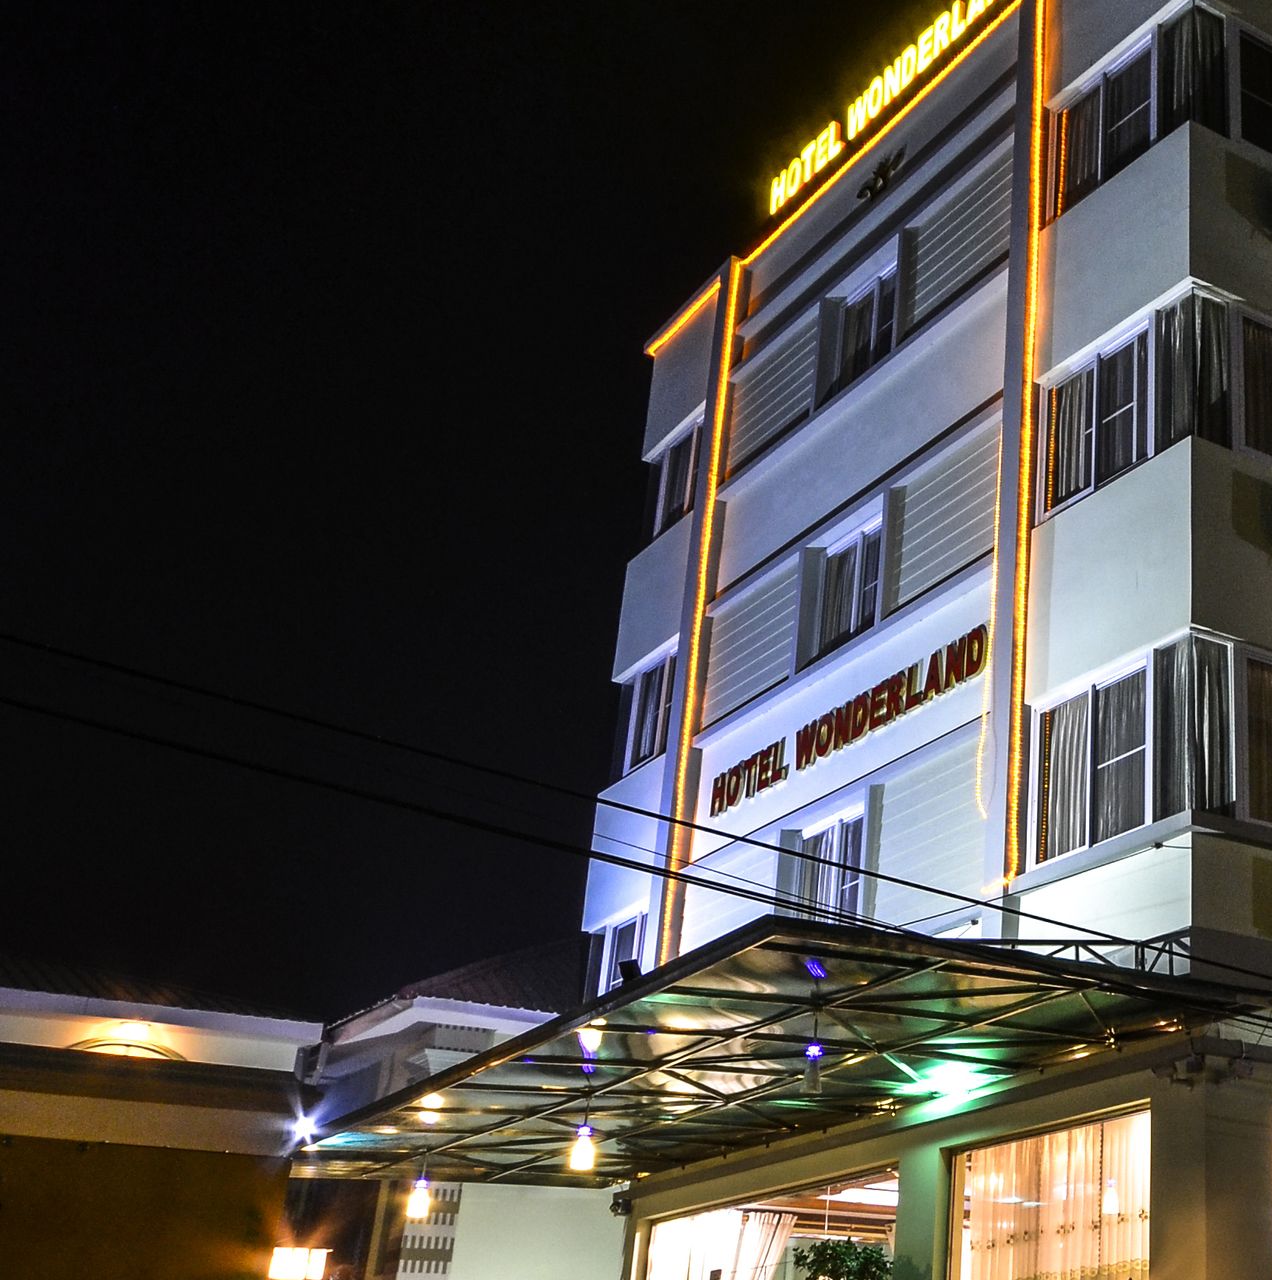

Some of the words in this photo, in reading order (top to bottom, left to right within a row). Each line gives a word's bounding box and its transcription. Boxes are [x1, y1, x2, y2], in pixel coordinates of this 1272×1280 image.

[769, 120, 845, 215] HOTEL
[710, 737, 788, 817] HOTEL
[795, 624, 989, 770] WONDERLAND
